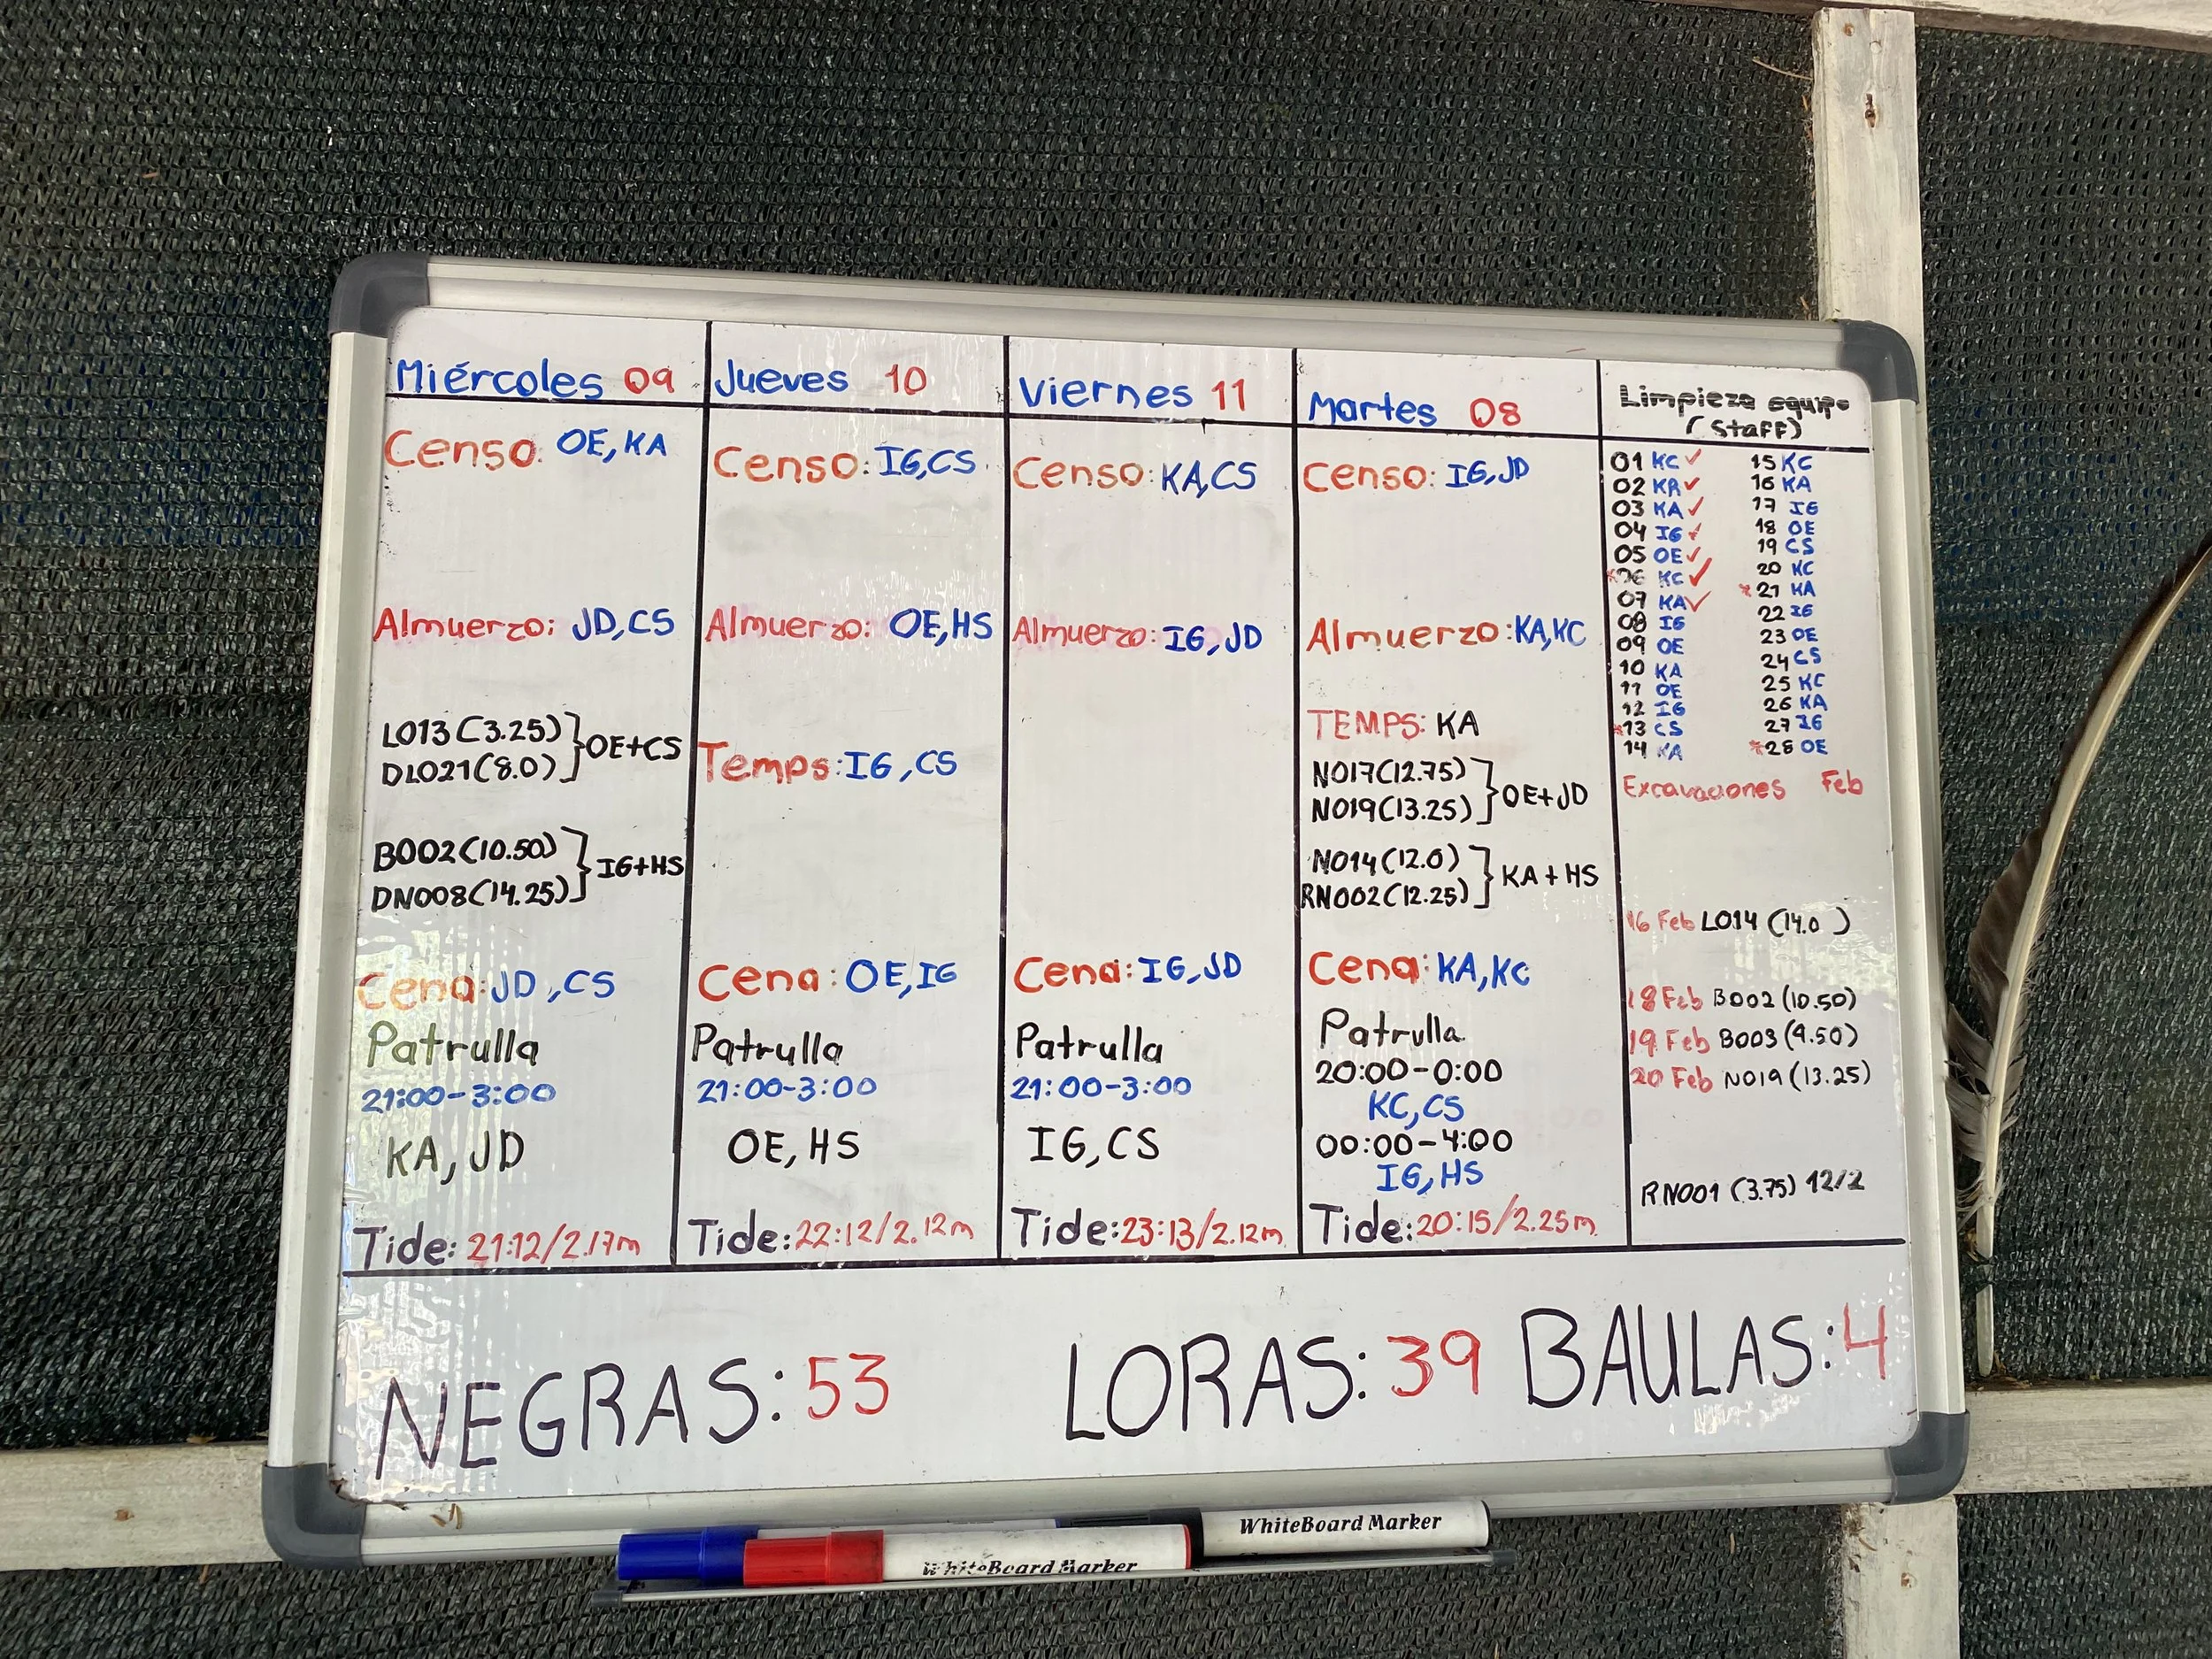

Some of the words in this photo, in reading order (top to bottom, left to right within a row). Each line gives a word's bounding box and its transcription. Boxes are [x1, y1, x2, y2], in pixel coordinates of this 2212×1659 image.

[396, 358, 603, 400] Miércoles
[624, 365, 674, 395] 09
[715, 359, 849, 397] Jueves
[885, 364, 926, 395] 10
[1019, 377, 1193, 409] Viernes
[1211, 379, 1246, 411] 11
[1619, 384, 1755, 417] Limpieza
[1309, 392, 1437, 426] Martes
[1470, 398, 1521, 427] 08
[714, 446, 869, 483] Censo:
[1013, 457, 1153, 489] Censo:
[1610, 451, 1642, 472] 01
[1652, 451, 1679, 471] KC
[1751, 454, 1776, 470] 15
[1781, 452, 1812, 473] KC
[1303, 463, 1436, 492] Censo:
[1613, 478, 1646, 495] 02
[1750, 474, 1775, 490] 16
[1782, 476, 1811, 492] KA
[1612, 499, 1644, 517] 03
[1654, 501, 1684, 519] KA
[1752, 497, 1776, 512] 17
[1789, 501, 1818, 515] IG
[1614, 521, 1647, 541] 04
[1655, 526, 1682, 542] IG
[1755, 518, 1776, 534] 18
[1787, 520, 1814, 535] OE
[1614, 544, 1646, 565] 05
[1653, 547, 1683, 565] OE
[1757, 538, 1777, 555] 19
[1785, 538, 1814, 555] CS
[1658, 570, 1684, 588] KC
[1756, 561, 1781, 575] 20
[1792, 559, 1814, 576] KC
[1617, 590, 1647, 609] 07
[1659, 595, 1686, 611] KA
[1756, 582, 1779, 598] 21
[1791, 580, 1816, 597] KA
[373, 608, 555, 641] Almuerzo:
[572, 608, 675, 641] JD,CS
[705, 605, 871, 642] Almuerzo:
[889, 607, 992, 647] OE,HS
[1617, 611, 1647, 633] 08
[1659, 616, 1685, 630] IG
[1757, 605, 1786, 622] 22
[1790, 603, 1813, 618] IG
[1012, 617, 1156, 649] Almuerzo:
[1306, 618, 1512, 655] Almuerzo:
[1515, 615, 1586, 651] KA,KC
[1616, 635, 1646, 655] 09
[1656, 638, 1684, 655] OE
[1760, 628, 1786, 644] 23
[1792, 627, 1818, 642] OE
[1619, 659, 1645, 675] 10
[1655, 663, 1683, 681] KA
[1761, 653, 1788, 671] 24
[1793, 647, 1821, 664] CS
[1620, 681, 1640, 695] 11
[1656, 683, 1682, 699] OE
[1762, 674, 1790, 692] 25
[1798, 673, 1825, 691] KC
[1622, 701, 1645, 716] 12
[1654, 701, 1685, 717] IG
[1763, 697, 1792, 712] 26
[1800, 694, 1828, 711] KA
[1307, 710, 1425, 741] TEMPS:
[1437, 710, 1479, 740] KA
[1623, 720, 1646, 736] 13
[1655, 721, 1683, 736] CS
[1764, 718, 1790, 733] 27
[1795, 714, 1822, 730] IG
[1623, 740, 1647, 759] 14
[1764, 740, 1793, 755] 28
[1801, 739, 1828, 754] OE
[697, 741, 842, 784] Temps:
[1821, 769, 1863, 796] Feb
[1657, 910, 1695, 932] Feb
[698, 964, 836, 1002] Cena:
[1014, 956, 1132, 993] Cena:
[1309, 951, 1428, 986] Cena:
[1438, 951, 1530, 992] KA,KC
[357, 972, 486, 1010] Cena:
[1629, 985, 1656, 1012] 18
[1662, 986, 1703, 1011] Feb
[1320, 1007, 1464, 1048] Patrulla
[366, 1020, 539, 1068] Patrulla
[692, 1023, 843, 1066] Patrulla
[1017, 1022, 1163, 1064] Patrulla
[1630, 1029, 1658, 1057] 19
[1665, 1026, 1710, 1054] Feb
[1630, 1066, 1663, 1087] 20
[1671, 1066, 1714, 1092] Feb
[1369, 1090, 1464, 1130] KC,CS
[1377, 1158, 1484, 1195] IG,HS
[687, 1209, 791, 1256] Tide:
[1010, 1208, 1118, 1248] Tide:
[1309, 1200, 1412, 1244] Tide:
[353, 1221, 457, 1271] Tide:
[1521, 1303, 1834, 1409] BAULAS:
[1842, 1302, 1889, 1381] 4
[1064, 1333, 1368, 1441] LORAS:
[1387, 1328, 1481, 1397] 39
[375, 1357, 784, 1480] NEGRAS:
[807, 1353, 889, 1421] 53
[1240, 1515, 1363, 1534] WhiteBoard
[1369, 1514, 1441, 1531] Marker
[1058, 1559, 1138, 1574] Marker
